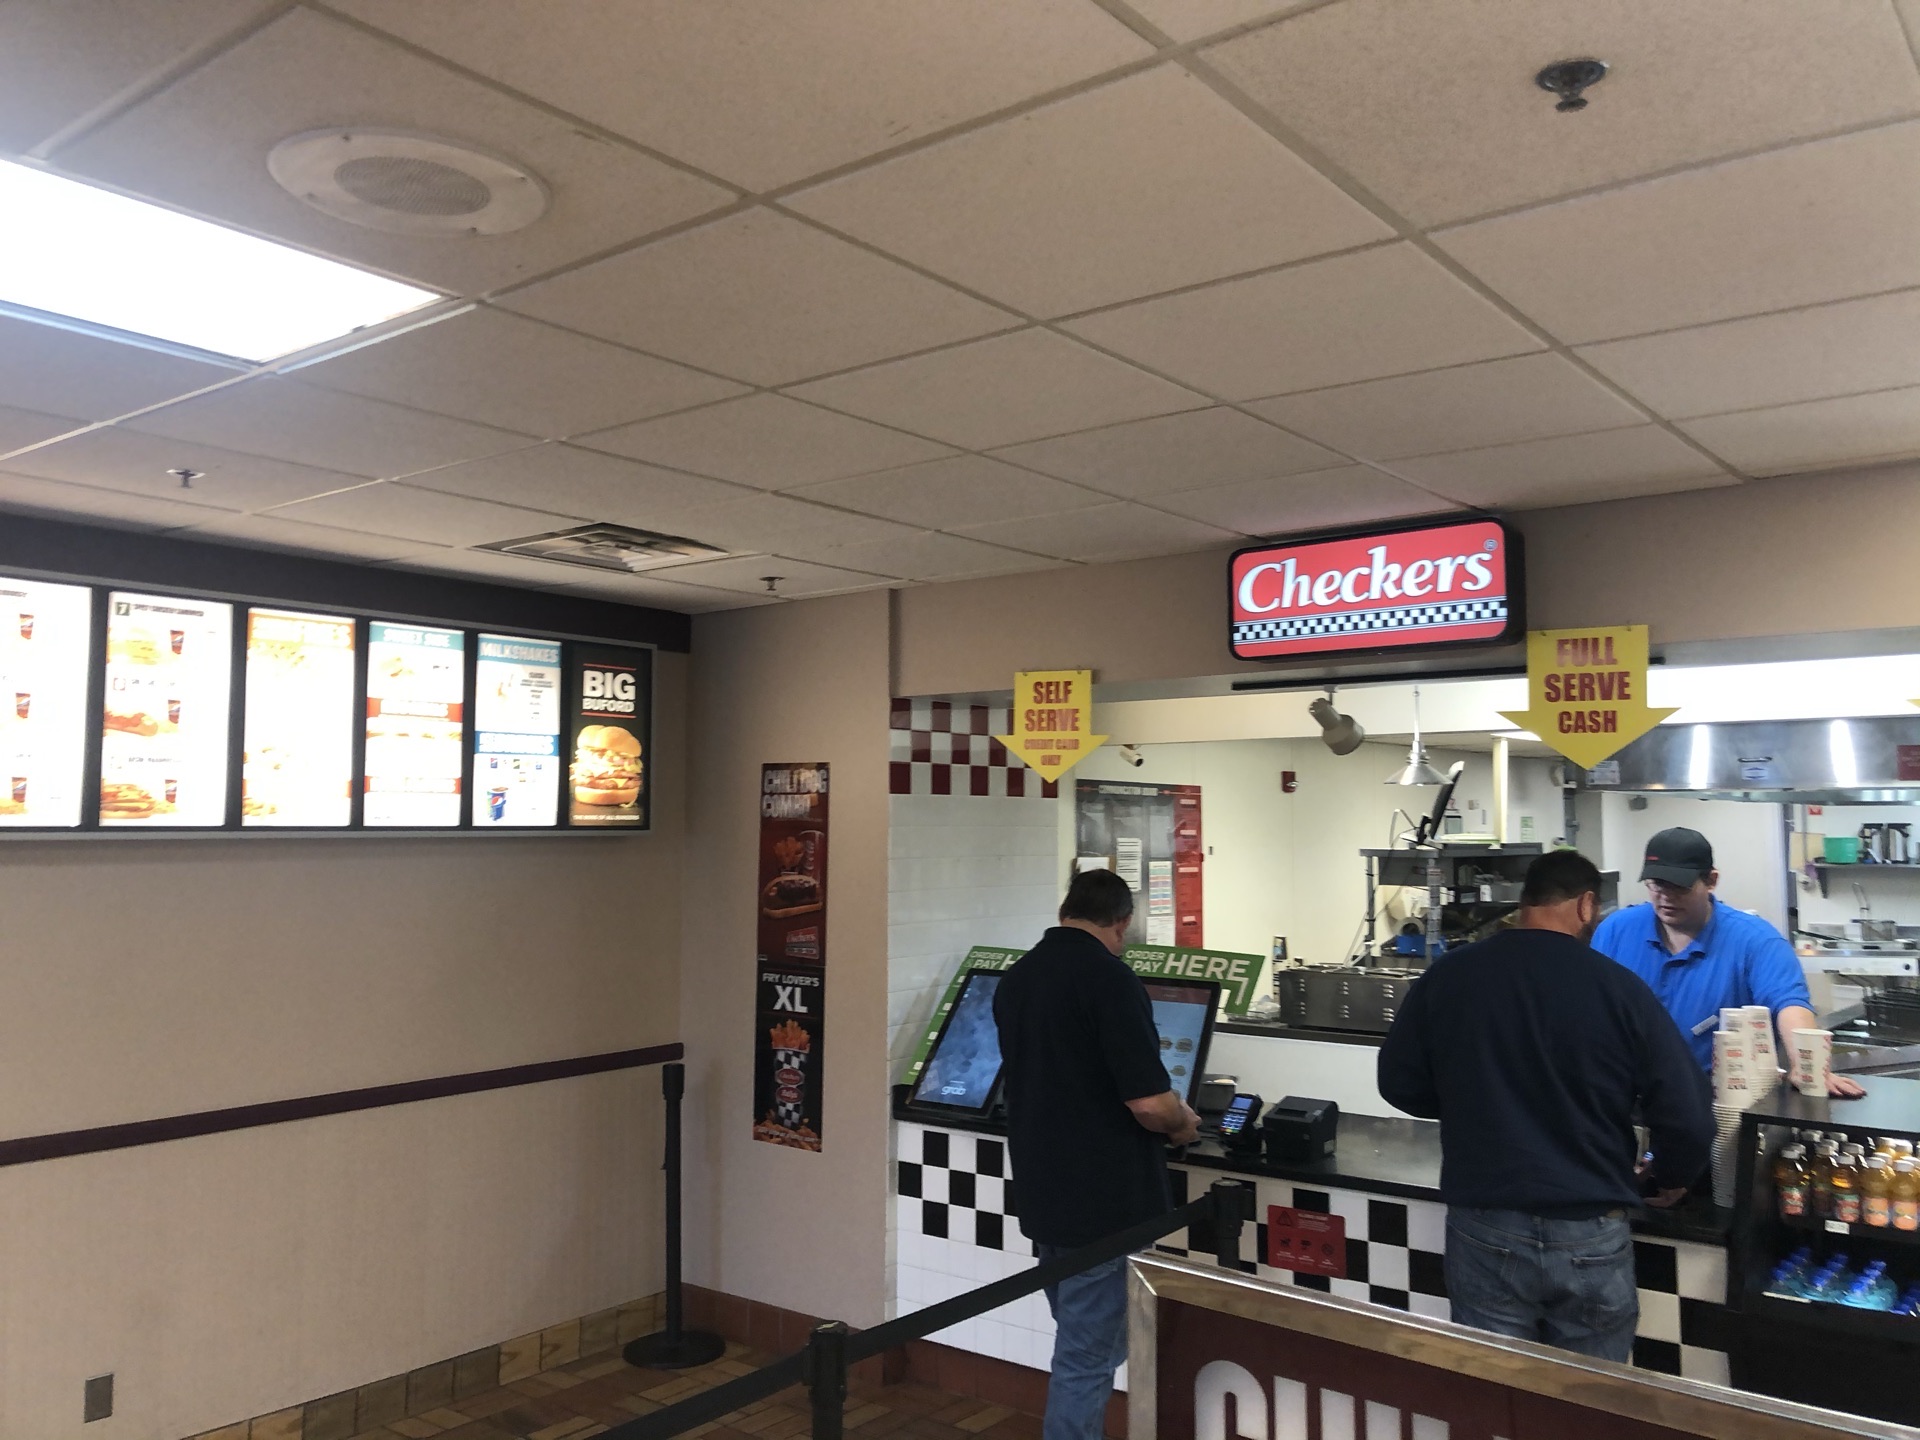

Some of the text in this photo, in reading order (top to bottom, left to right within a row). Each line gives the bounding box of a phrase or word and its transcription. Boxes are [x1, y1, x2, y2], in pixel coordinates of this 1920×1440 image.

[1238, 546, 1493, 613] Checkers
[480, 642, 559, 663] MILKSHAKES
[1557, 637, 1617, 667] FULL
[583, 670, 636, 700] BIG
[1033, 681, 1073, 704] SELF
[1544, 671, 1631, 702] SERVE
[582, 698, 635, 712] BUFORD
[1025, 708, 1080, 731] SERVE
[1559, 710, 1617, 733] CASH
[764, 770, 798, 793] CHILI
[970, 951, 1005, 960] ORDER
[972, 959, 1001, 970] PAY
[1125, 950, 1166, 960] ORDER
[1132, 960, 1163, 973] PAY
[1163, 952, 1251, 981] HERE
[762, 972, 820, 987] FRY LOVER'S
[773, 984, 809, 1013] XL
[941, 1086, 967, 1096] grab
